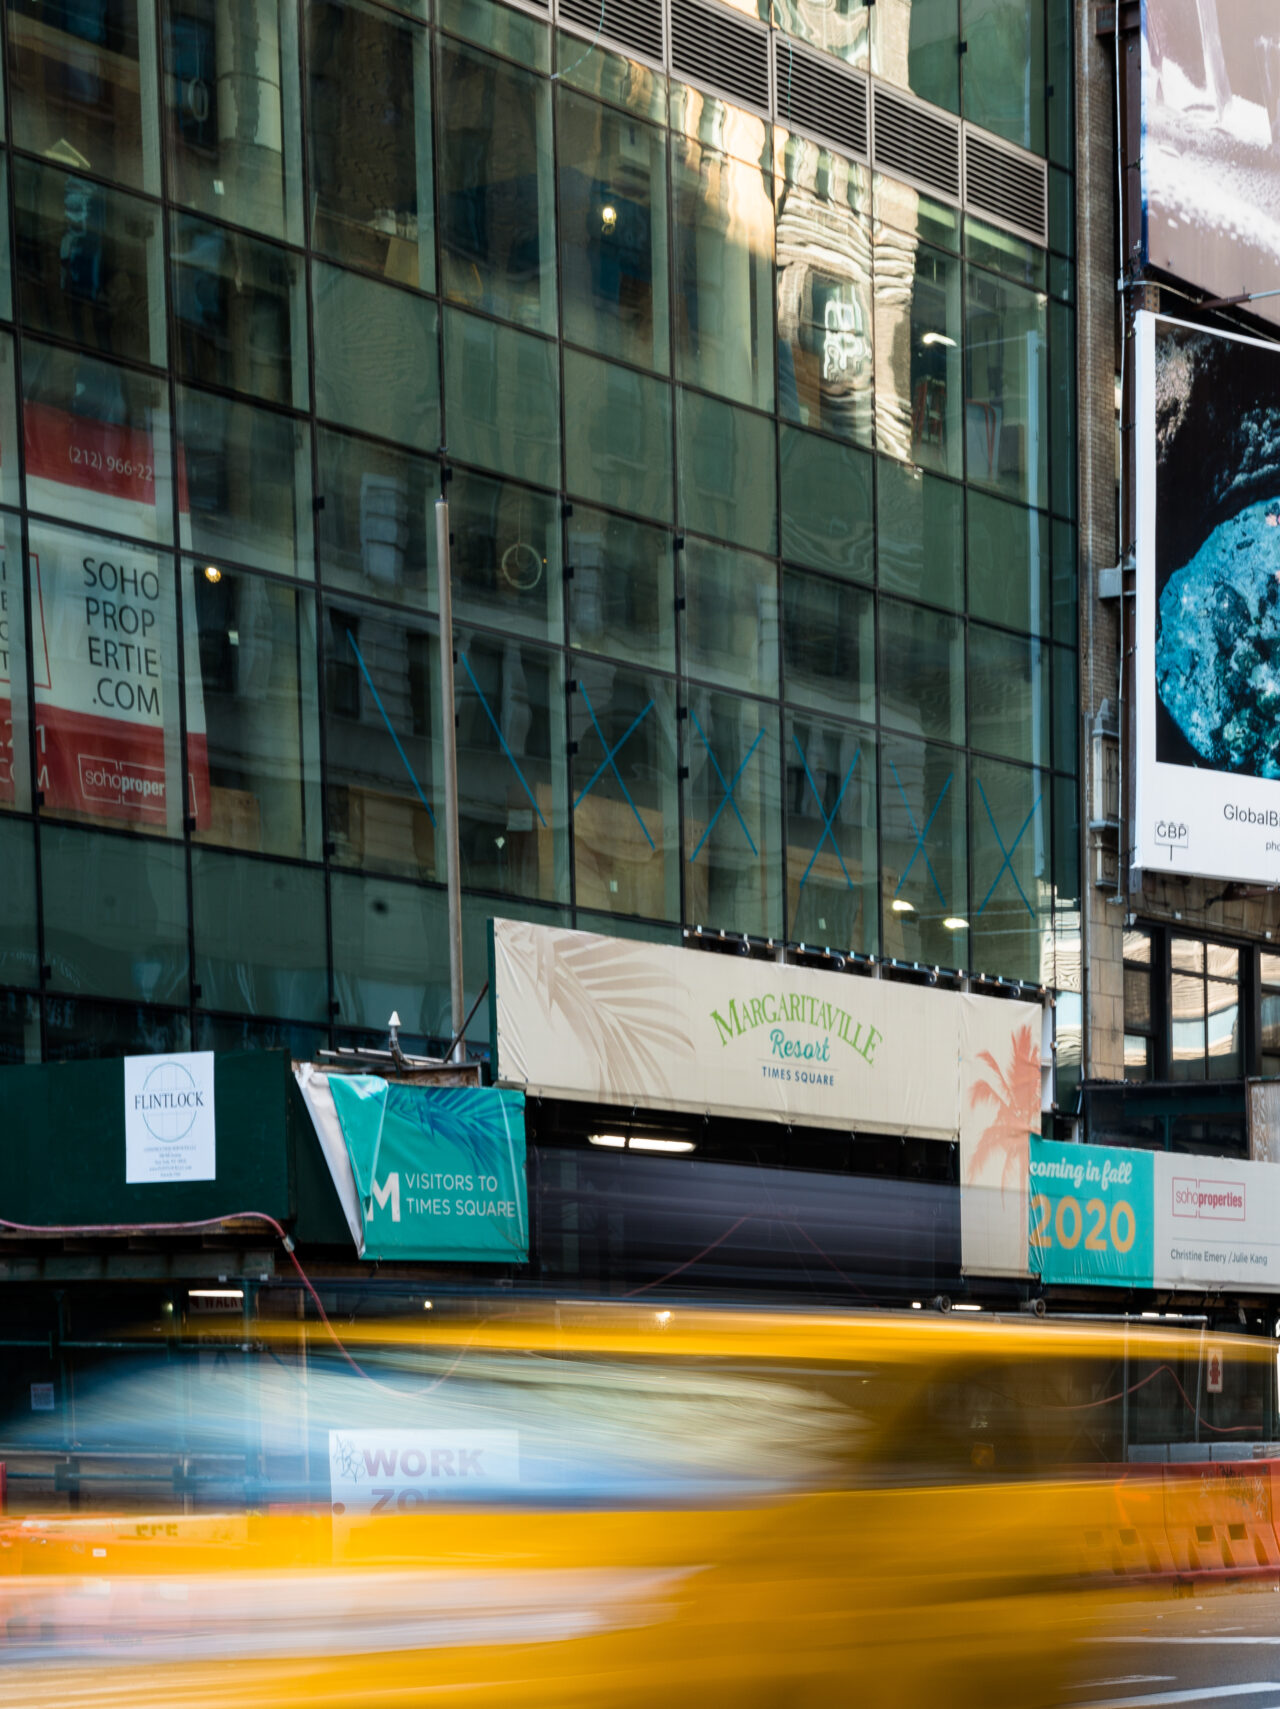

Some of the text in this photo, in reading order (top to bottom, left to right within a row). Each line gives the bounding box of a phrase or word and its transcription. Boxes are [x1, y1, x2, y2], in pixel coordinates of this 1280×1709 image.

[68, 445, 103, 471] (212)
[82, 557, 159, 601] SOHO
[85, 596, 155, 638] PROP
[92, 678, 160, 716] .COM
[1156, 824, 1187, 840] GBP
[709, 992, 883, 1066] MARGARITAVILLE
[769, 1027, 831, 1063] Resort
[762, 1066, 835, 1087] TIMES SQUARE
[134, 1090, 205, 1111] FLINTLOCK
[405, 1172, 498, 1193] VISITORS TO
[1029, 1157, 1133, 1191] coming in fall
[406, 1197, 516, 1218] TIMES SQUARE
[1175, 1187, 1243, 1210] sohoproperties
[1029, 1194, 1136, 1253] 2020
[1170, 1248, 1203, 1262] Christine
[1203, 1251, 1227, 1265] Emery
[1249, 1254, 1268, 1267] Kang
[362, 1448, 487, 1477] WORK
